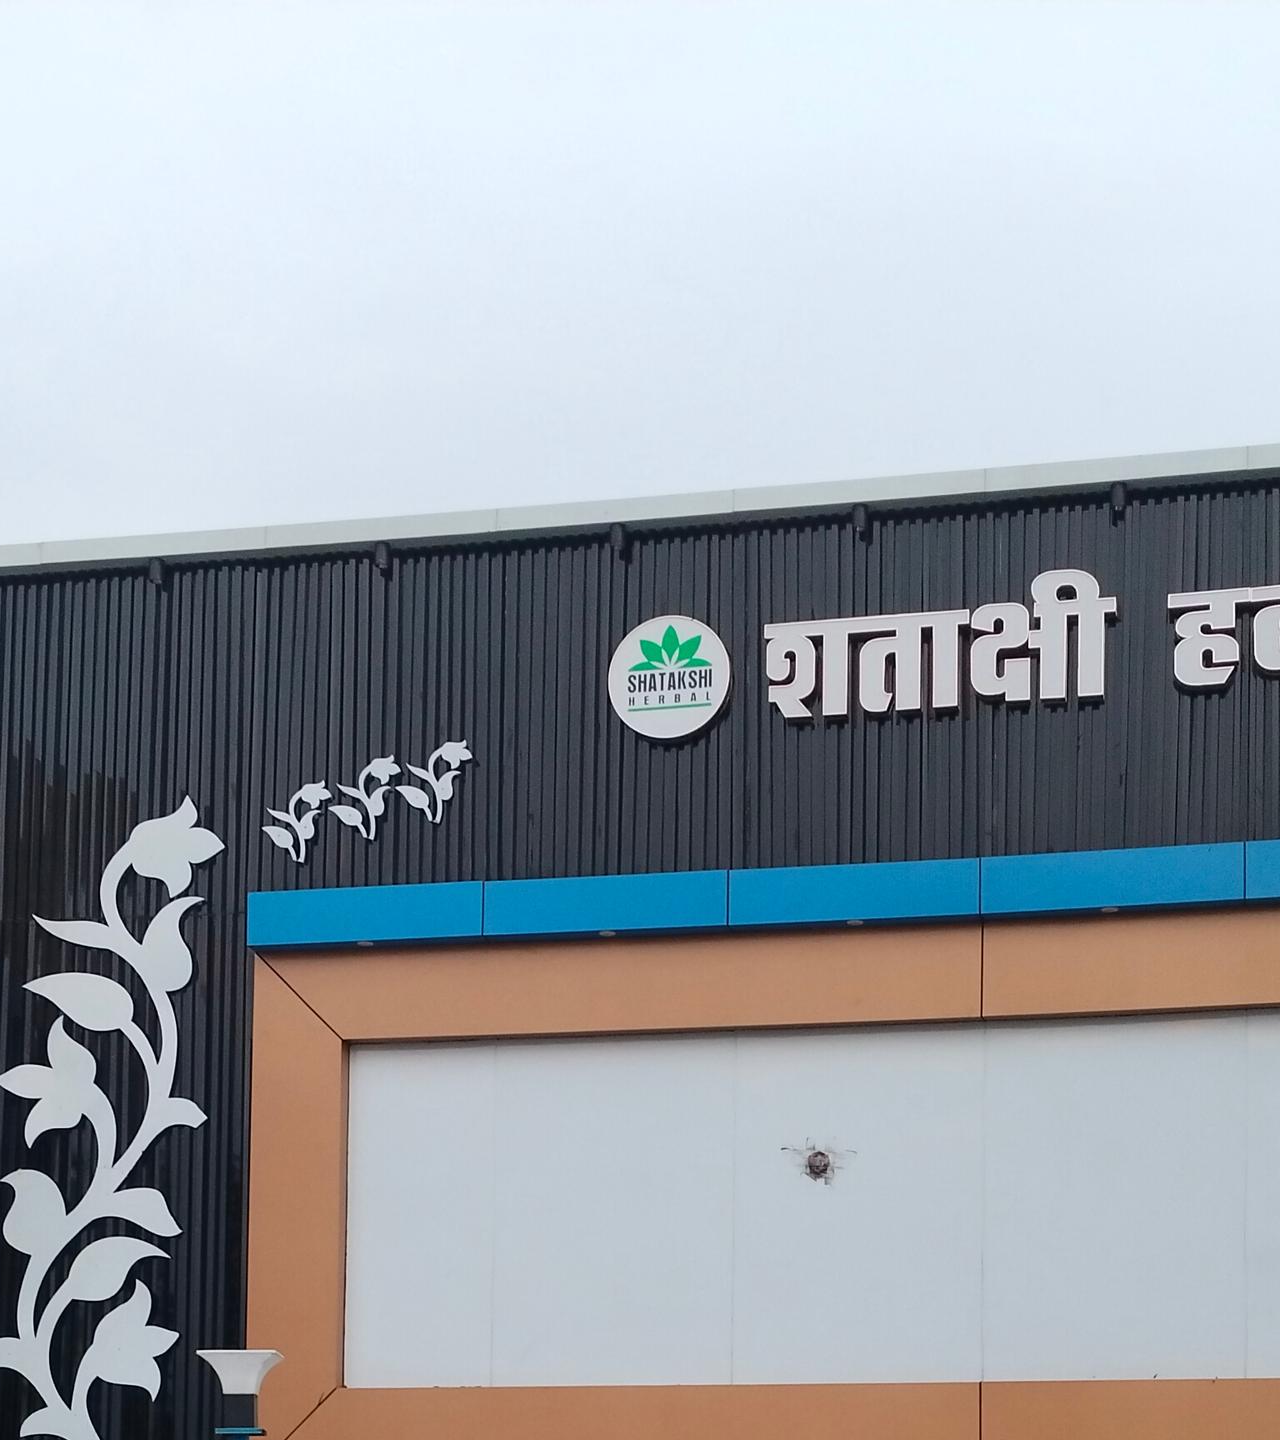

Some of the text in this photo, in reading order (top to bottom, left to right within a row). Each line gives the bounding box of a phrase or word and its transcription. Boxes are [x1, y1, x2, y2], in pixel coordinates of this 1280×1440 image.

[764, 568, 1118, 719] शताक्षी
[626, 668, 713, 694] SHATAKSHI
[627, 691, 712, 707] HERBAL
